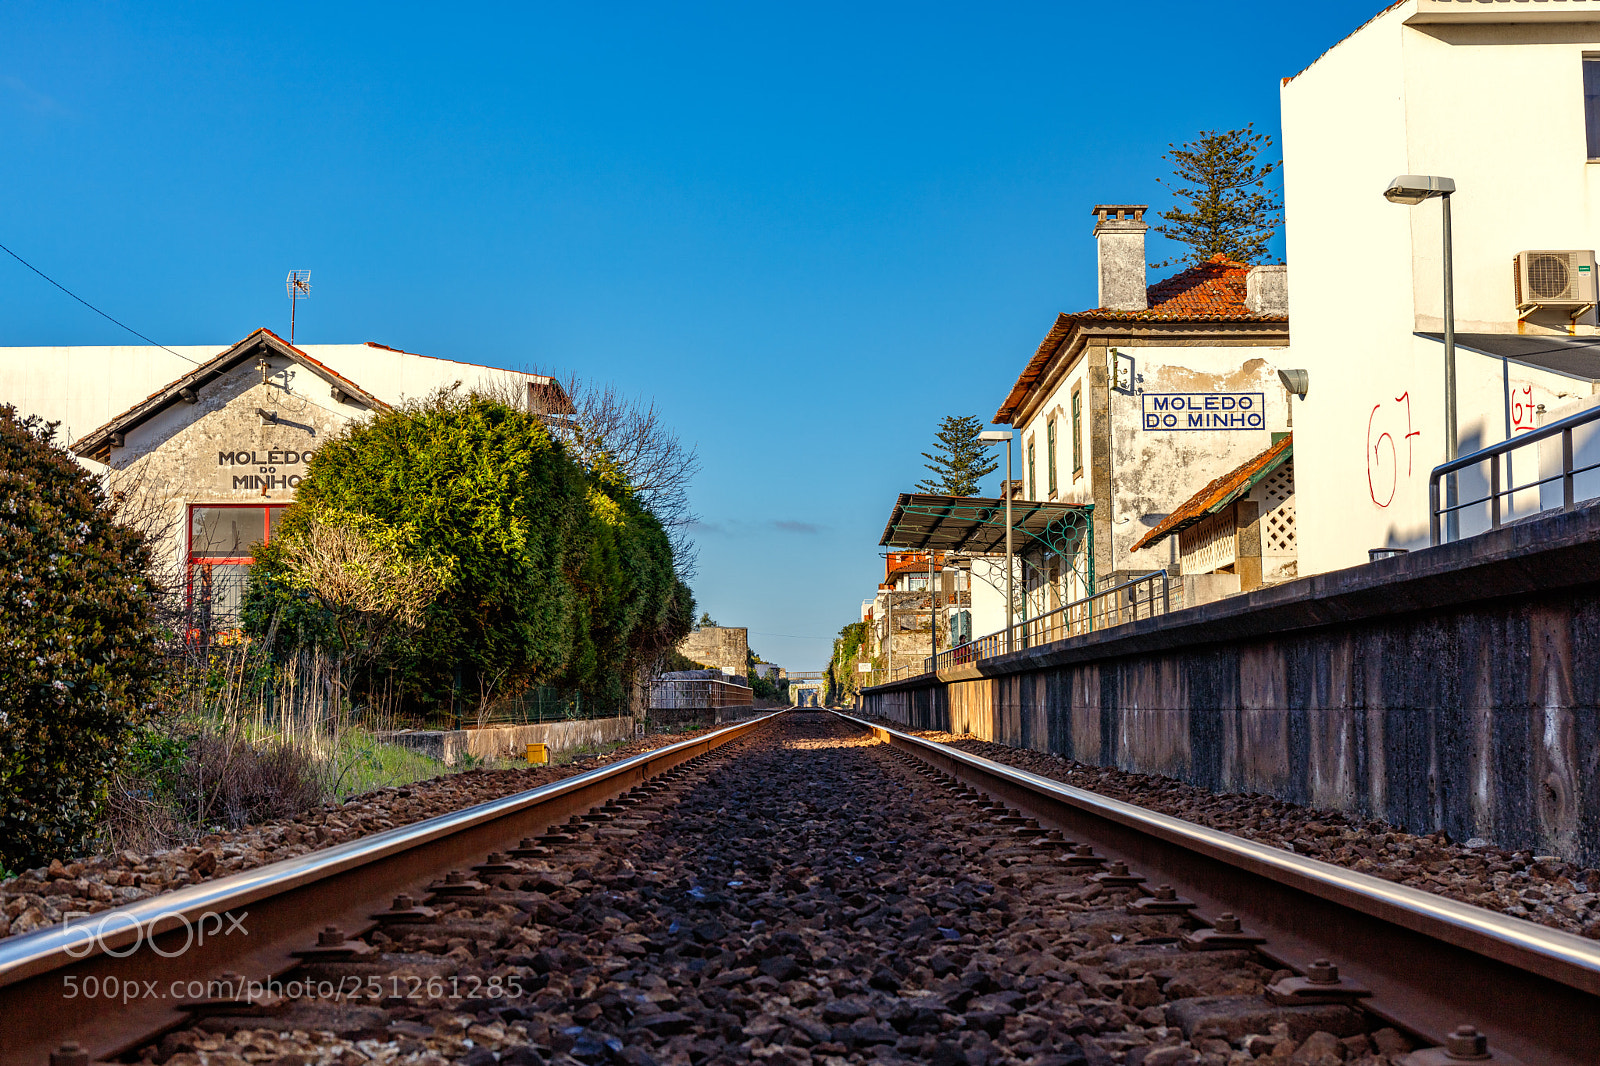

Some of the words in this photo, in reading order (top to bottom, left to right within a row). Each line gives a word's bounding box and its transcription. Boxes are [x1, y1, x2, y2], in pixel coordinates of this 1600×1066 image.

[1153, 396, 1253, 411] MOLEDO
[1146, 413, 1178, 428] DO
[1188, 413, 1262, 427] MINHO
[260, 466, 276, 474] DO
[232, 474, 303, 490] MINHO
